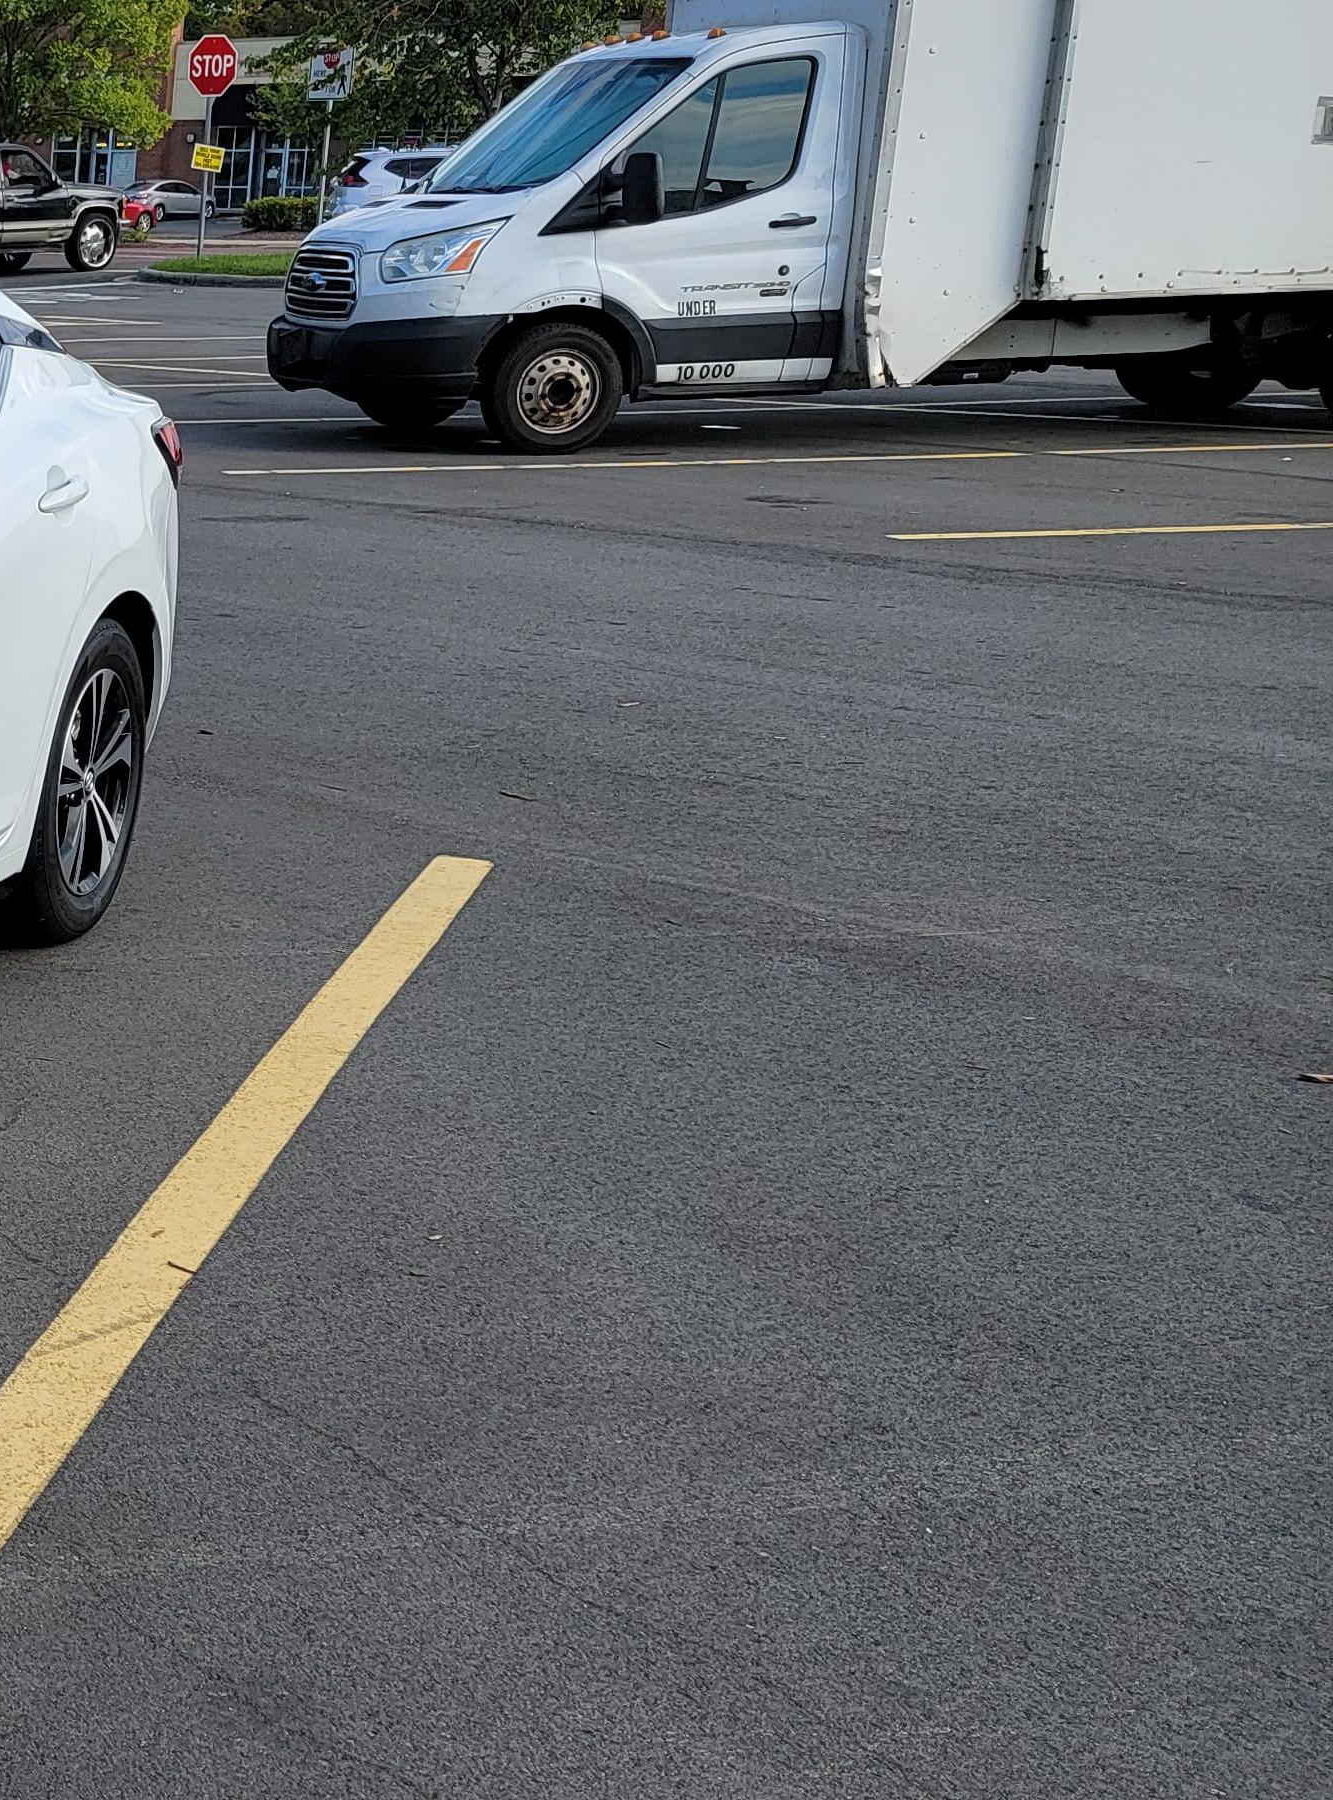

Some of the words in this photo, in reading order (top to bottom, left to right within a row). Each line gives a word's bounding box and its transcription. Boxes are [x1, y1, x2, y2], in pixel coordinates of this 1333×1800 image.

[191, 54, 234, 78] STOP
[324, 53, 340, 63] STOP
[677, 299, 717, 317] UNDER
[677, 365, 694, 381] 10
[699, 363, 735, 379] 000
